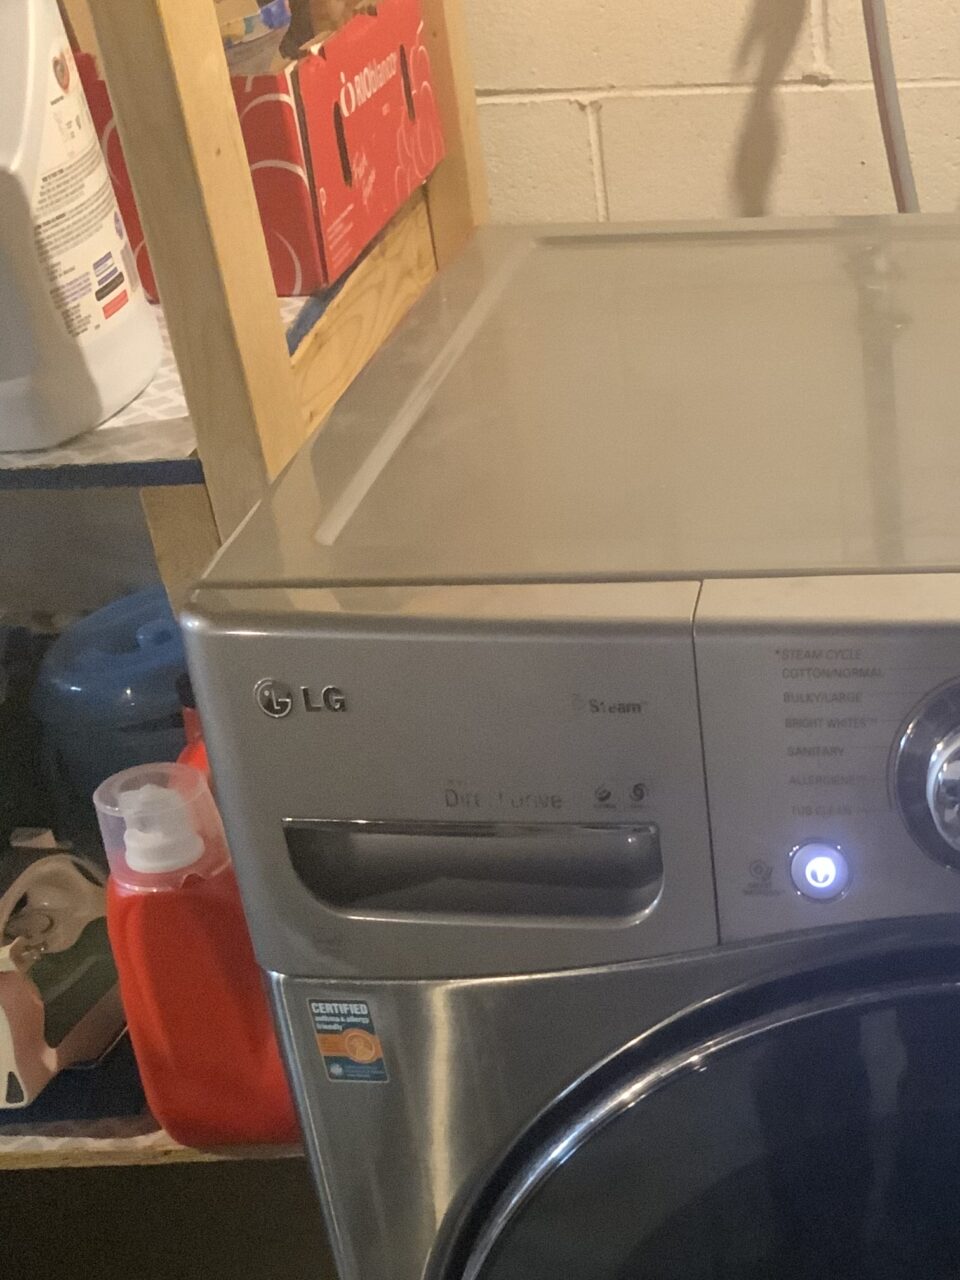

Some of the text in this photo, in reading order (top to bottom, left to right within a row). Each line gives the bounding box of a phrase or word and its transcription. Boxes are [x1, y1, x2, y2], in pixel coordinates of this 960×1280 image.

[300, 685, 346, 713] LG
[783, 692, 863, 703] BULKY/LARGE
[785, 717, 823, 729] BRIGHT
[787, 746, 845, 757] SANITARY
[311, 1002, 369, 1015] CERTIFIED
